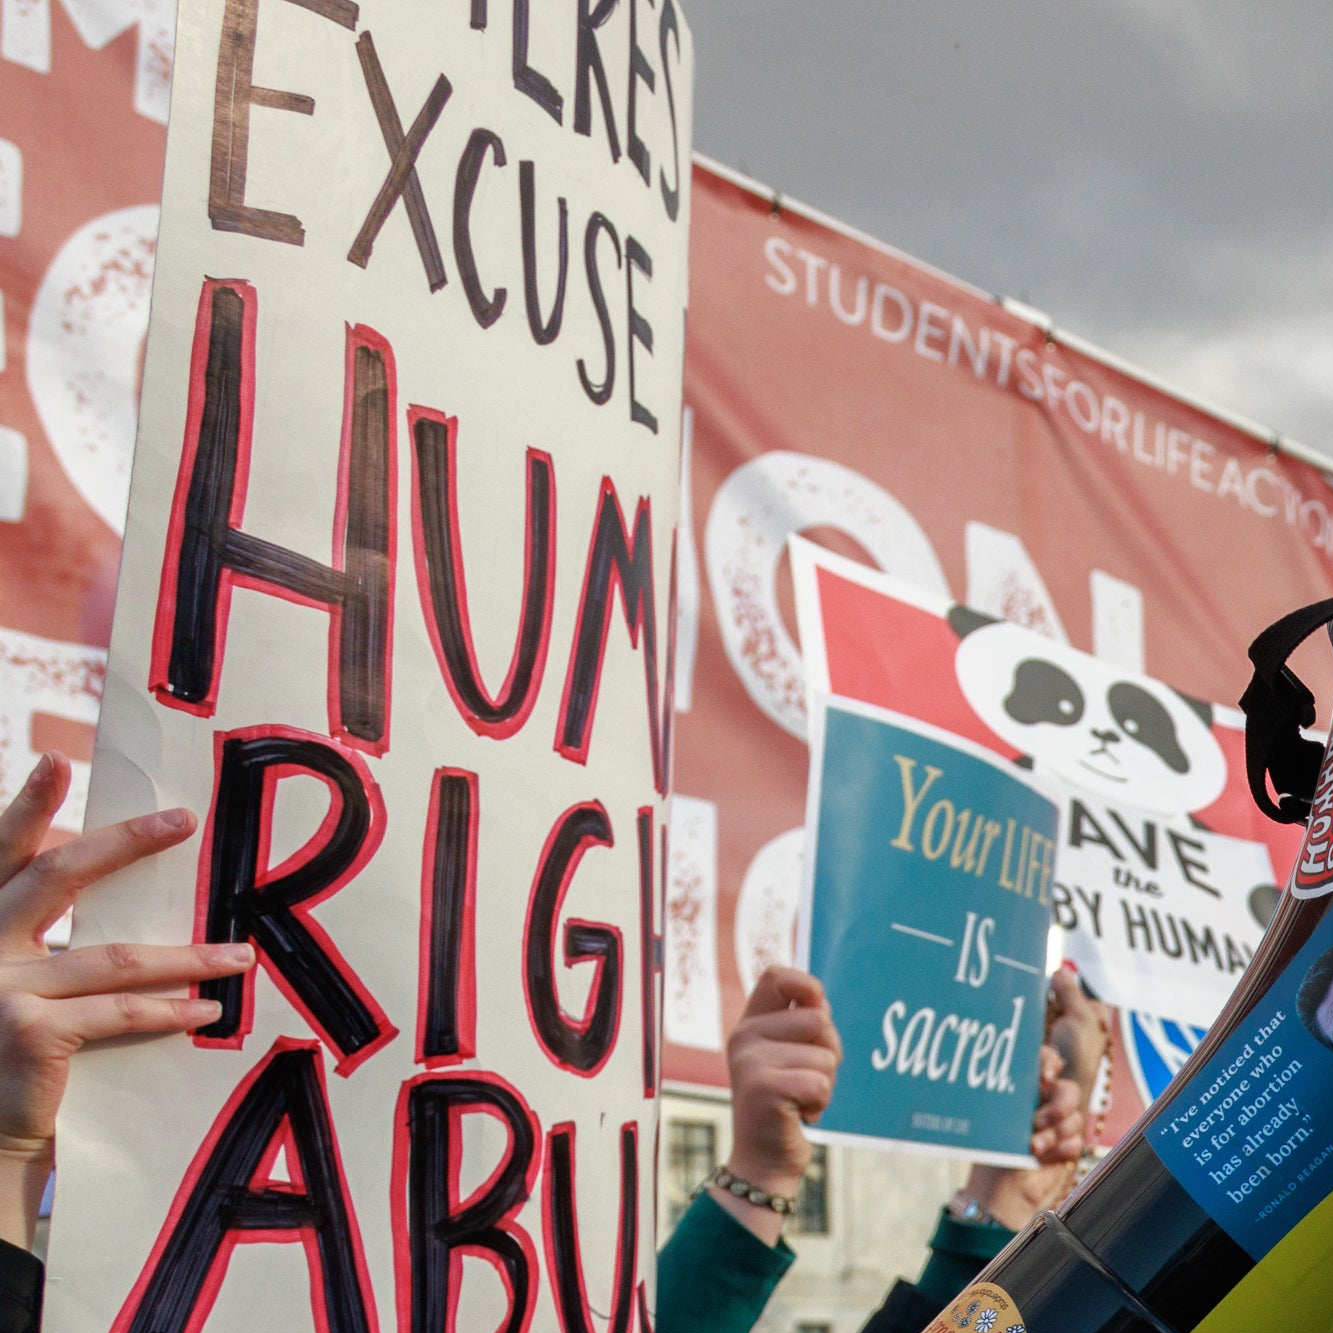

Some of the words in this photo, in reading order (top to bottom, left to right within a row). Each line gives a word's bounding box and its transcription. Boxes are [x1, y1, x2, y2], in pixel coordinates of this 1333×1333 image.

[207, 0, 658, 435] EXCUSE
[148, 275, 678, 799] HUM
[889, 754, 1002, 878] Your
[1000, 817, 1057, 907] LIFE
[1069, 797, 1223, 899] AVE
[1053, 882, 1103, 939] BY
[1121, 898, 1254, 974] HUMA
[1112, 866, 1165, 899] the
[954, 911, 994, 988] IS
[871, 995, 1025, 1094] sacred.
[1199, 1044, 1255, 1105] noticed
[1253, 1010, 1287, 1046] that
[1182, 1079, 1251, 1149] everyone
[1249, 1044, 1283, 1079] who
[1193, 1149, 1213, 1167] is
[1210, 1123, 1237, 1152] for
[1237, 1059, 1303, 1127] abortion
[1208, 1155, 1243, 1186] has
[1241, 1097, 1302, 1158] already
[1225, 1164, 1272, 1205] been
